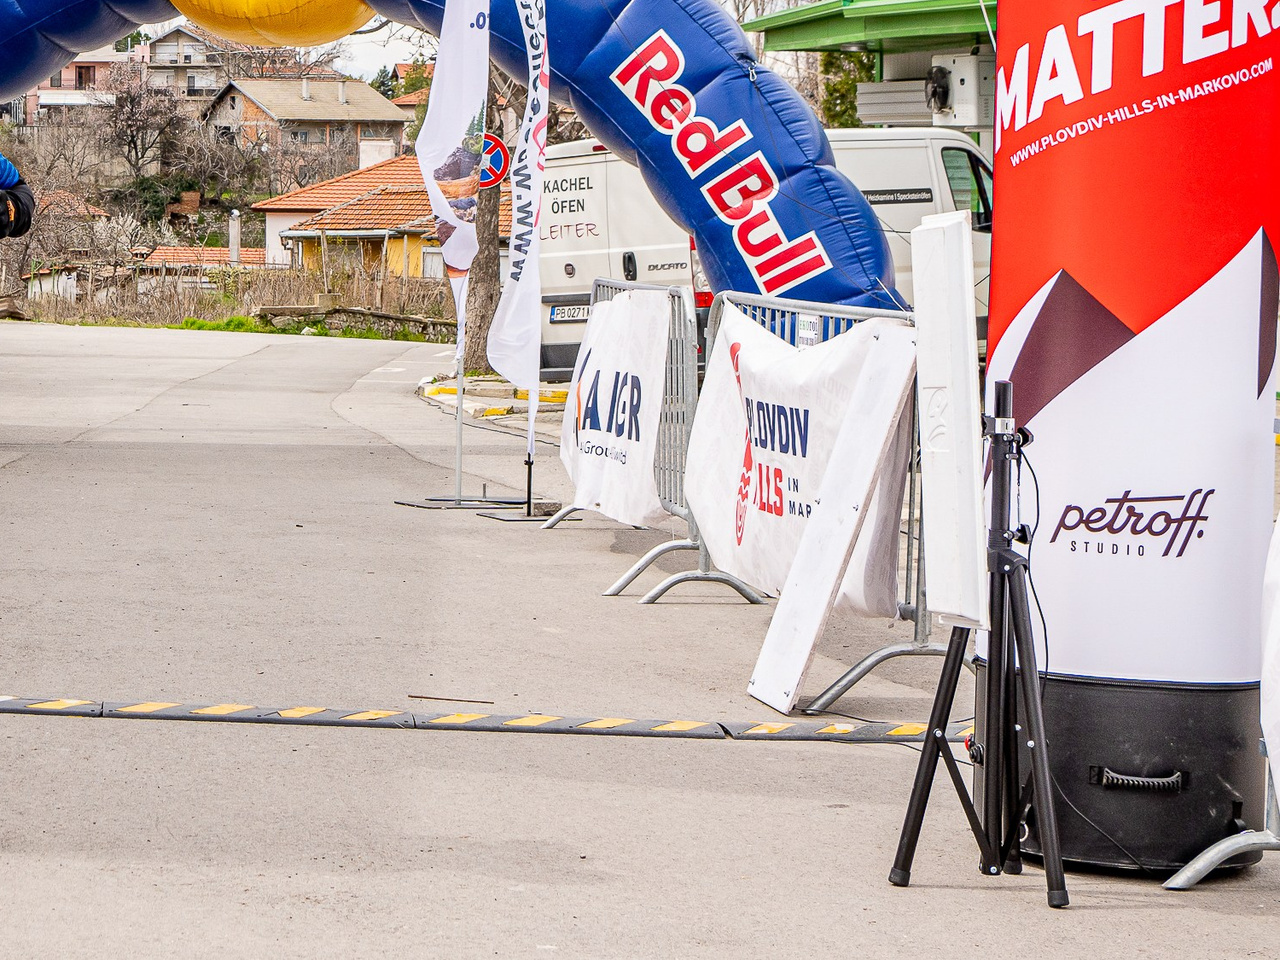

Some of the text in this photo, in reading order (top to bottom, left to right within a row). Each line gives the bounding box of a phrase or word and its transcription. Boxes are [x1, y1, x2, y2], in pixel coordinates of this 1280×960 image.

[1009, 57, 1273, 168] WWW.PLOVDIV-HILLS-IN-MARKOVO.COM
[613, 32, 828, 296] Red Bull
[543, 176, 593, 194] KACHEL
[551, 197, 585, 214] ÖFEN
[539, 222, 600, 241] LEITER
[648, 262, 688, 271] DUCATO
[788, 477, 799, 493] IN
[1070, 540, 1146, 557] STUDIO
